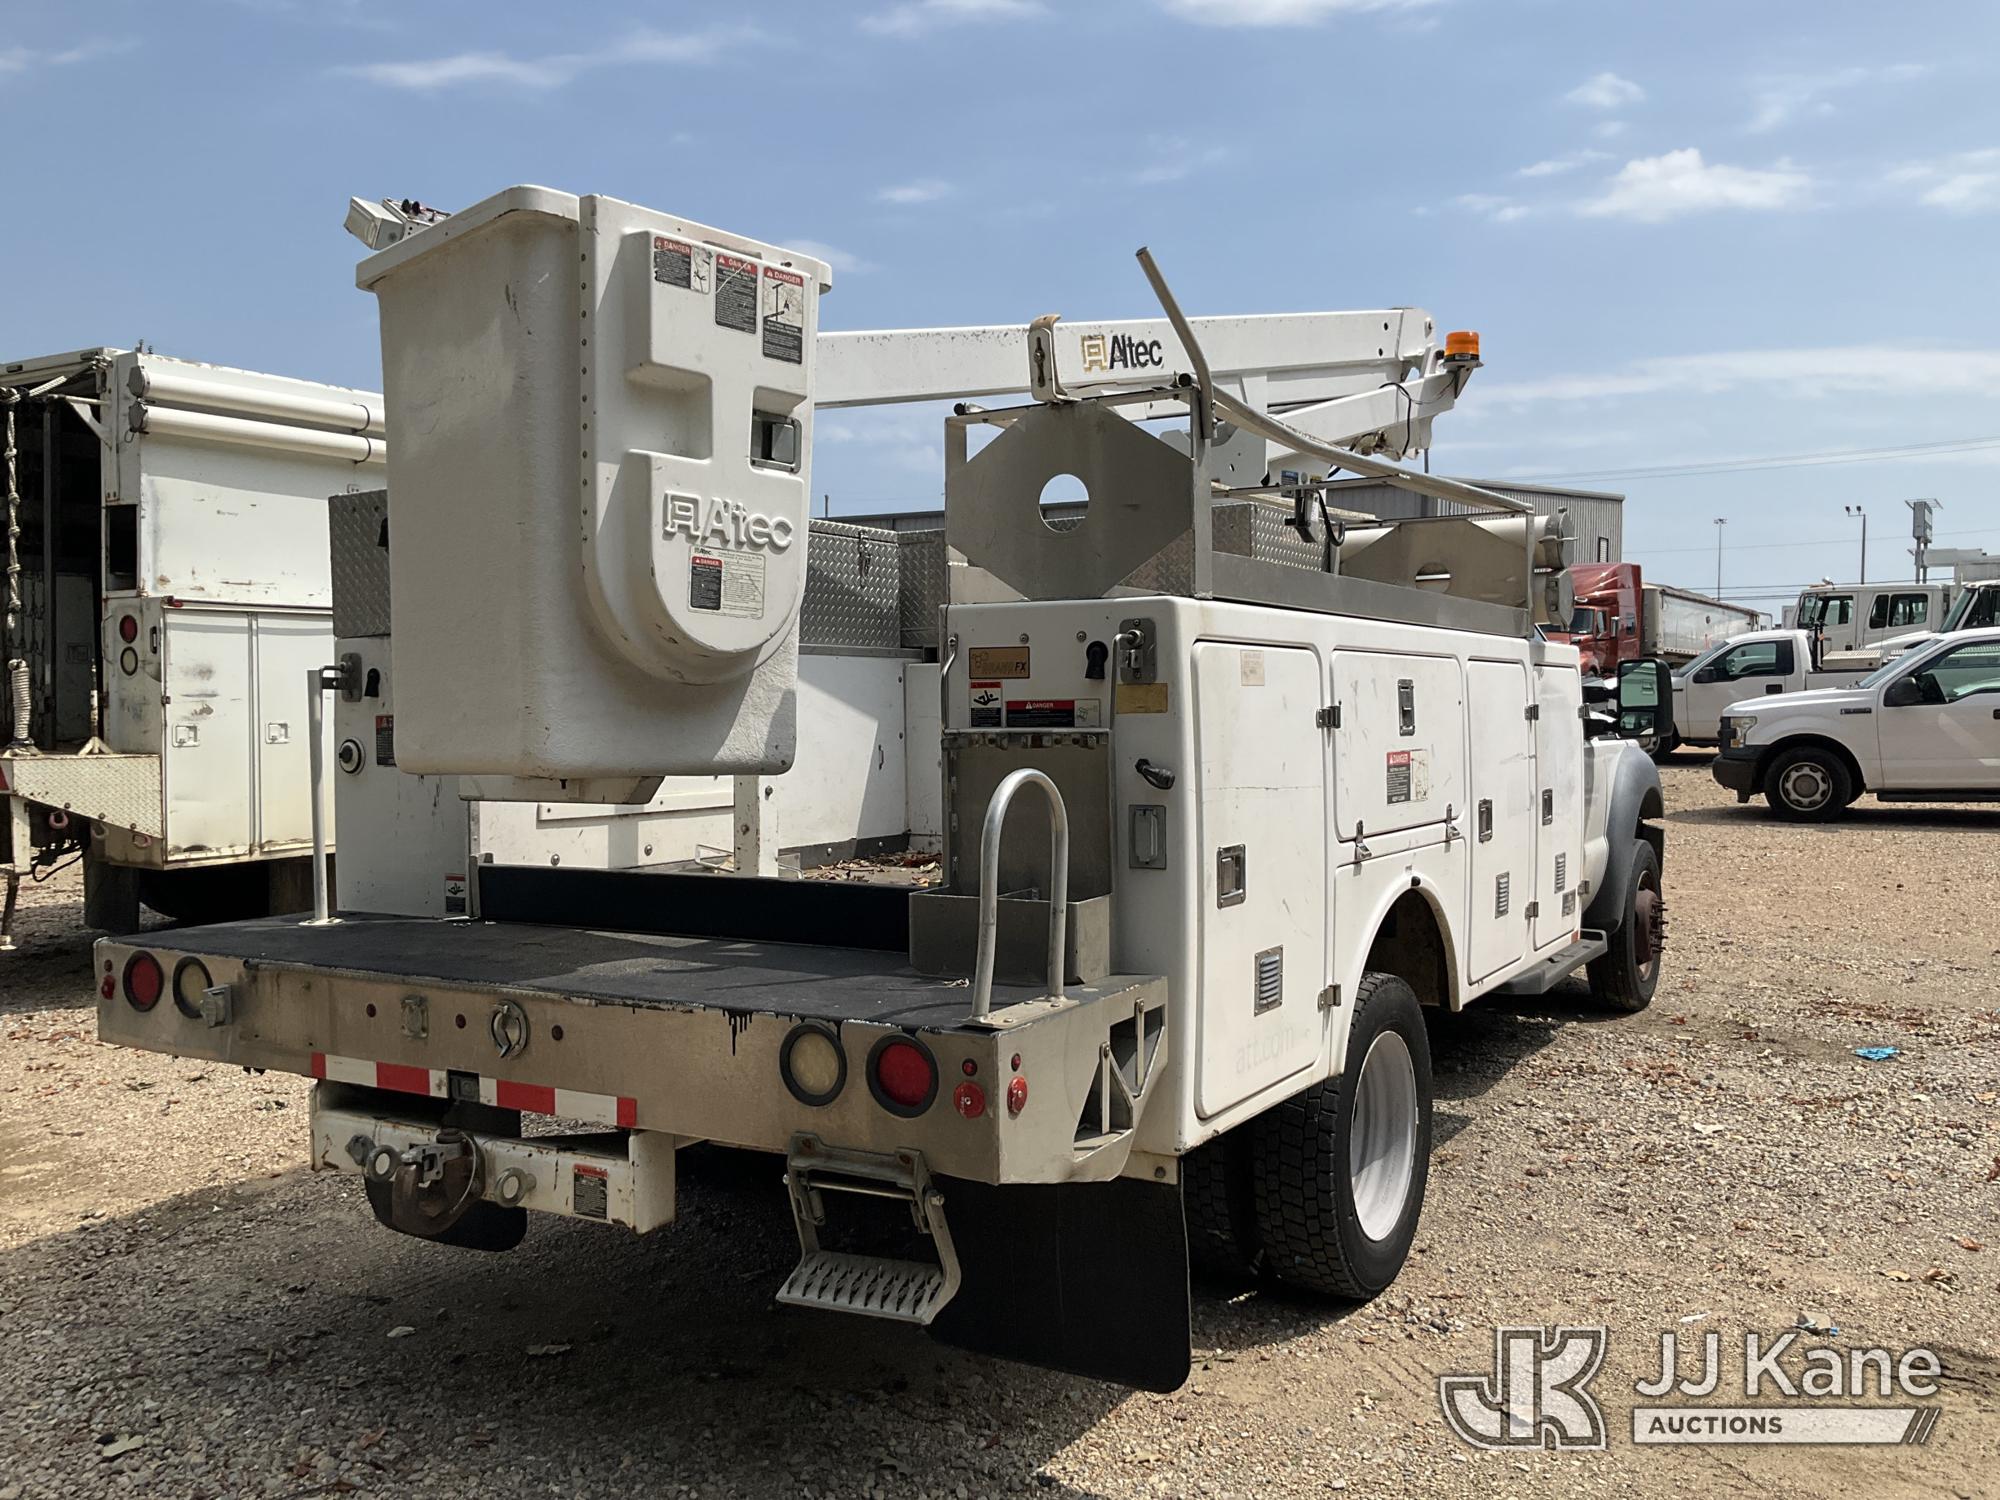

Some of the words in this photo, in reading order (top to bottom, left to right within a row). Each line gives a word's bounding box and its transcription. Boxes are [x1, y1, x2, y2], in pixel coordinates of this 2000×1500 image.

[663, 241, 690, 254] DANGER
[774, 272, 801, 284] DANGER
[1109, 334, 1163, 370] Altec
[701, 497, 793, 549] Altec
